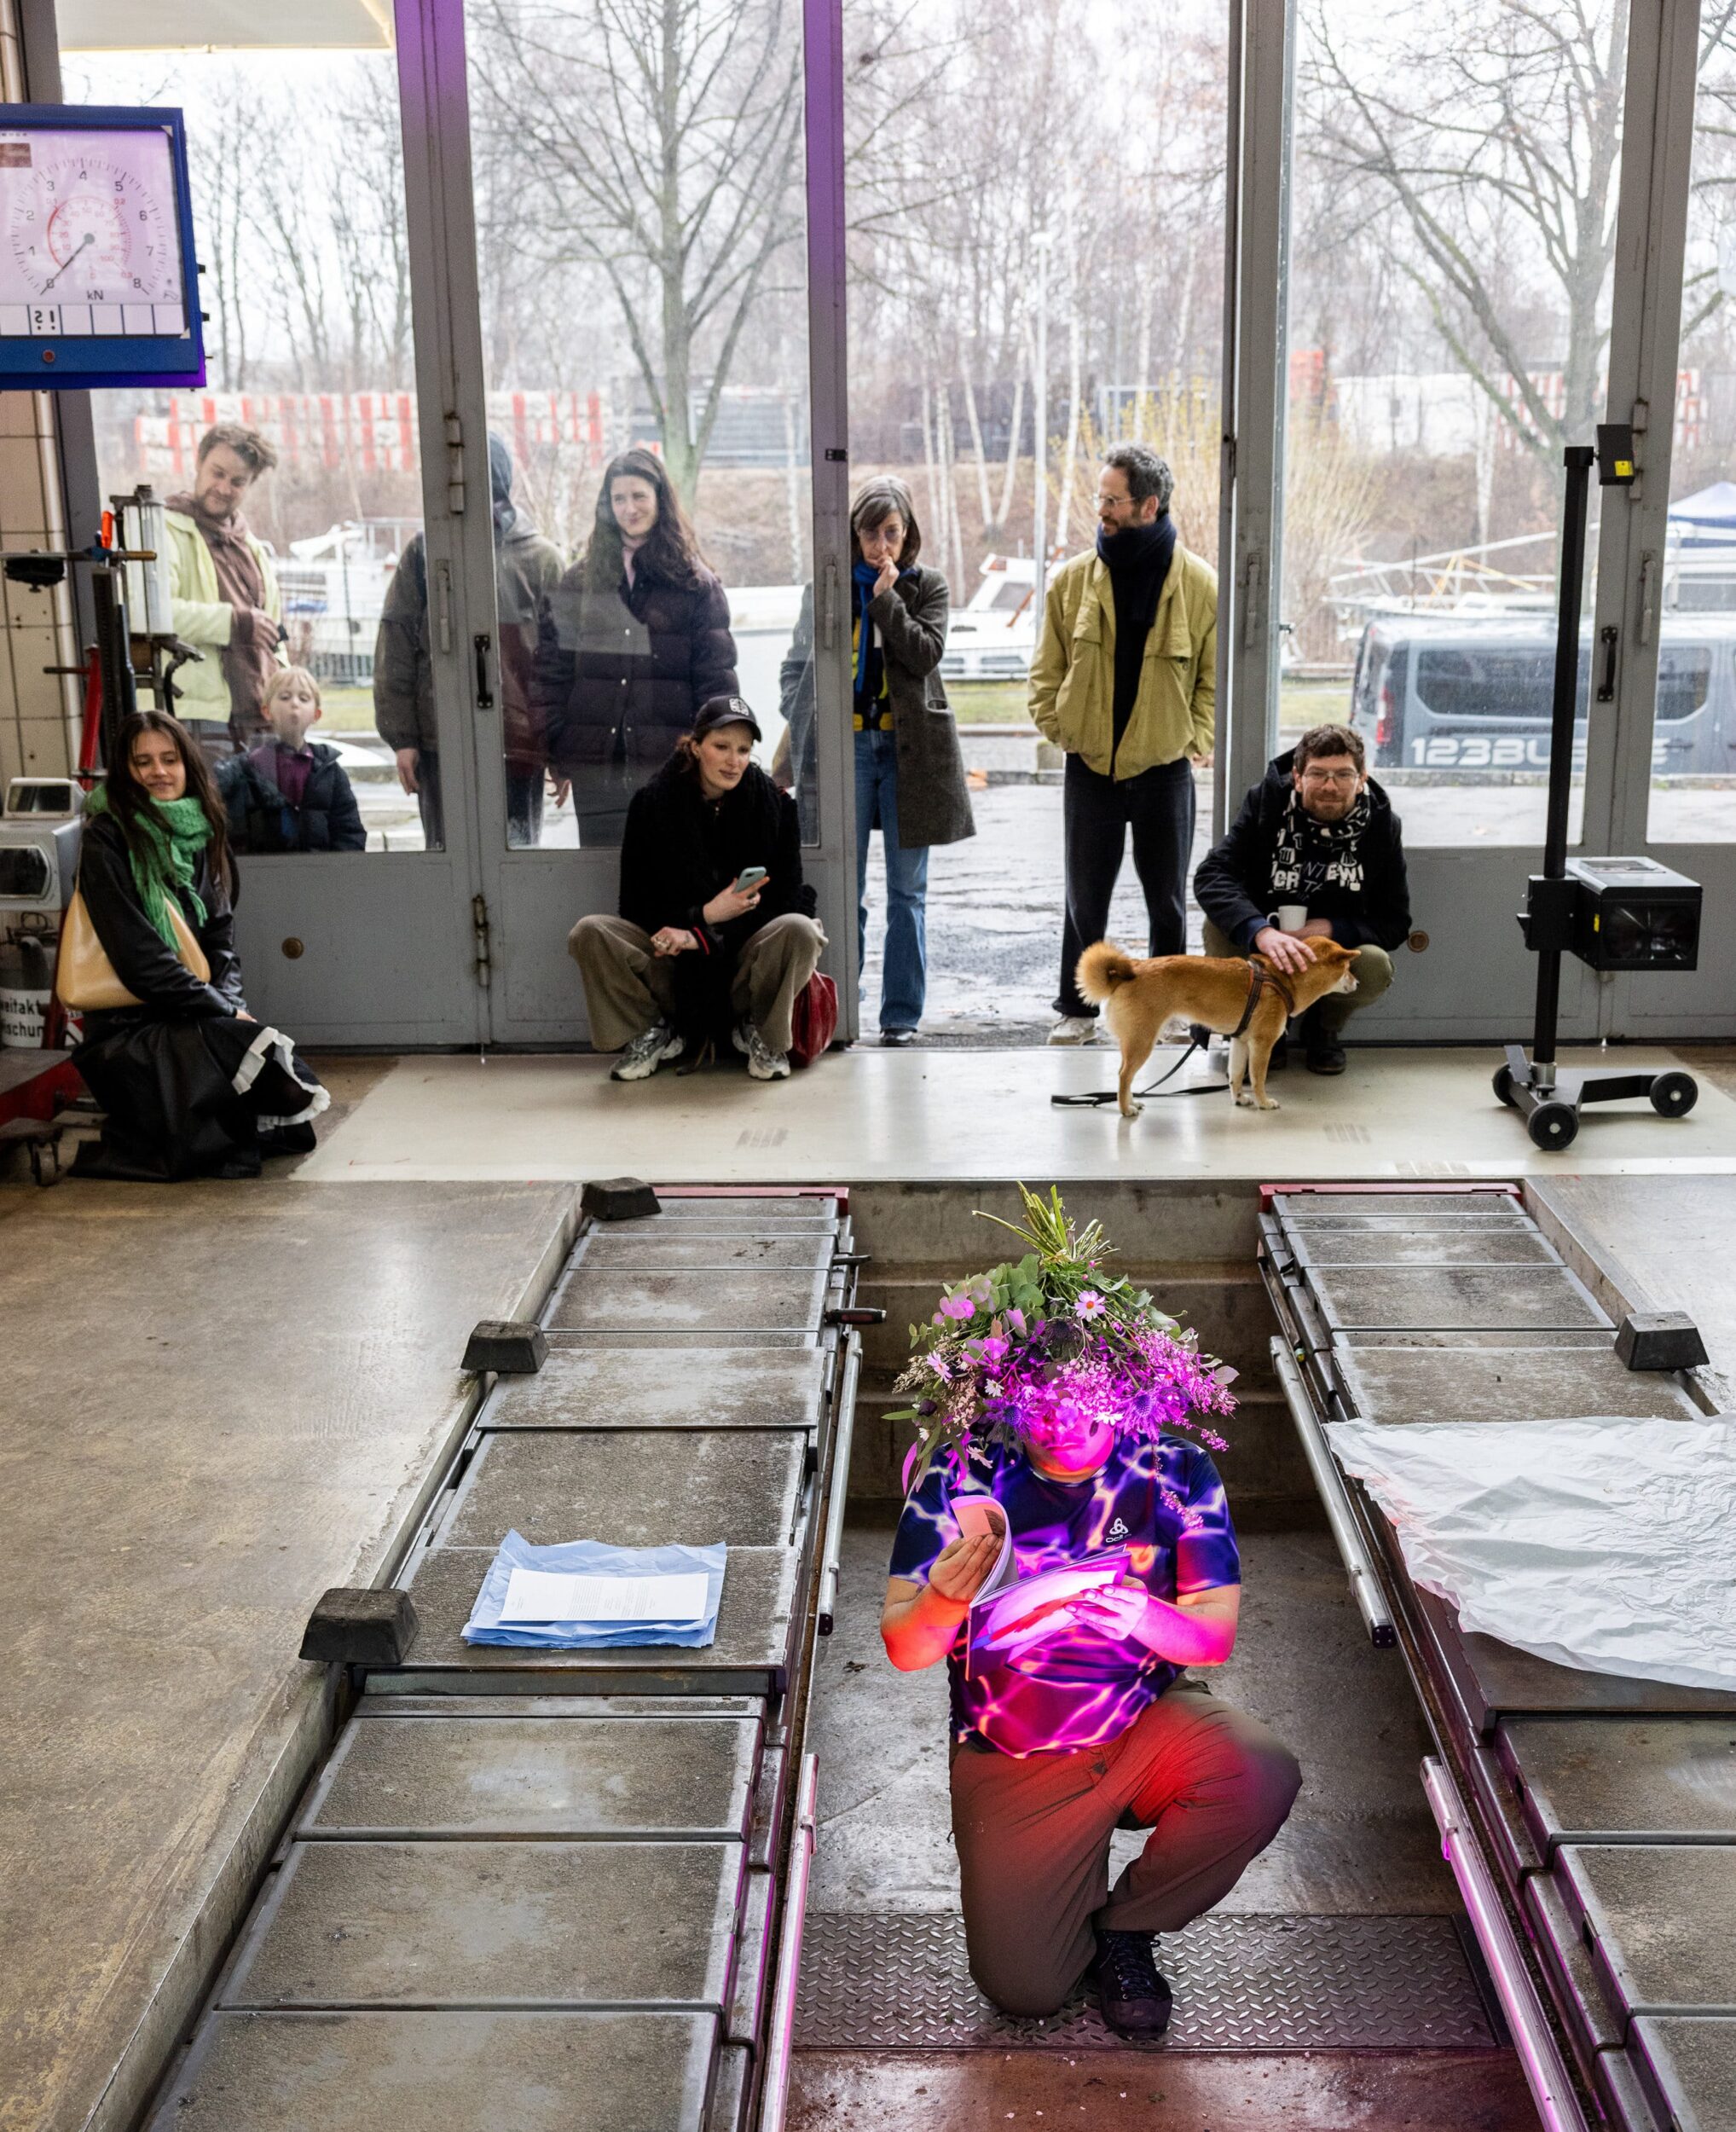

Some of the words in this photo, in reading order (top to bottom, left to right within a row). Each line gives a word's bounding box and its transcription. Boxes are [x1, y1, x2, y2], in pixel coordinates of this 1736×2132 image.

[78, 171, 87, 181] 4
[46, 181, 55, 191] 3
[115, 181, 123, 192] 5
[26, 210, 35, 221] 2
[139, 210, 148, 221] 6
[29, 246, 36, 256] 1
[146, 246, 153, 256] 7
[133, 278, 142, 289] 8
[86, 290, 104, 300] kN
